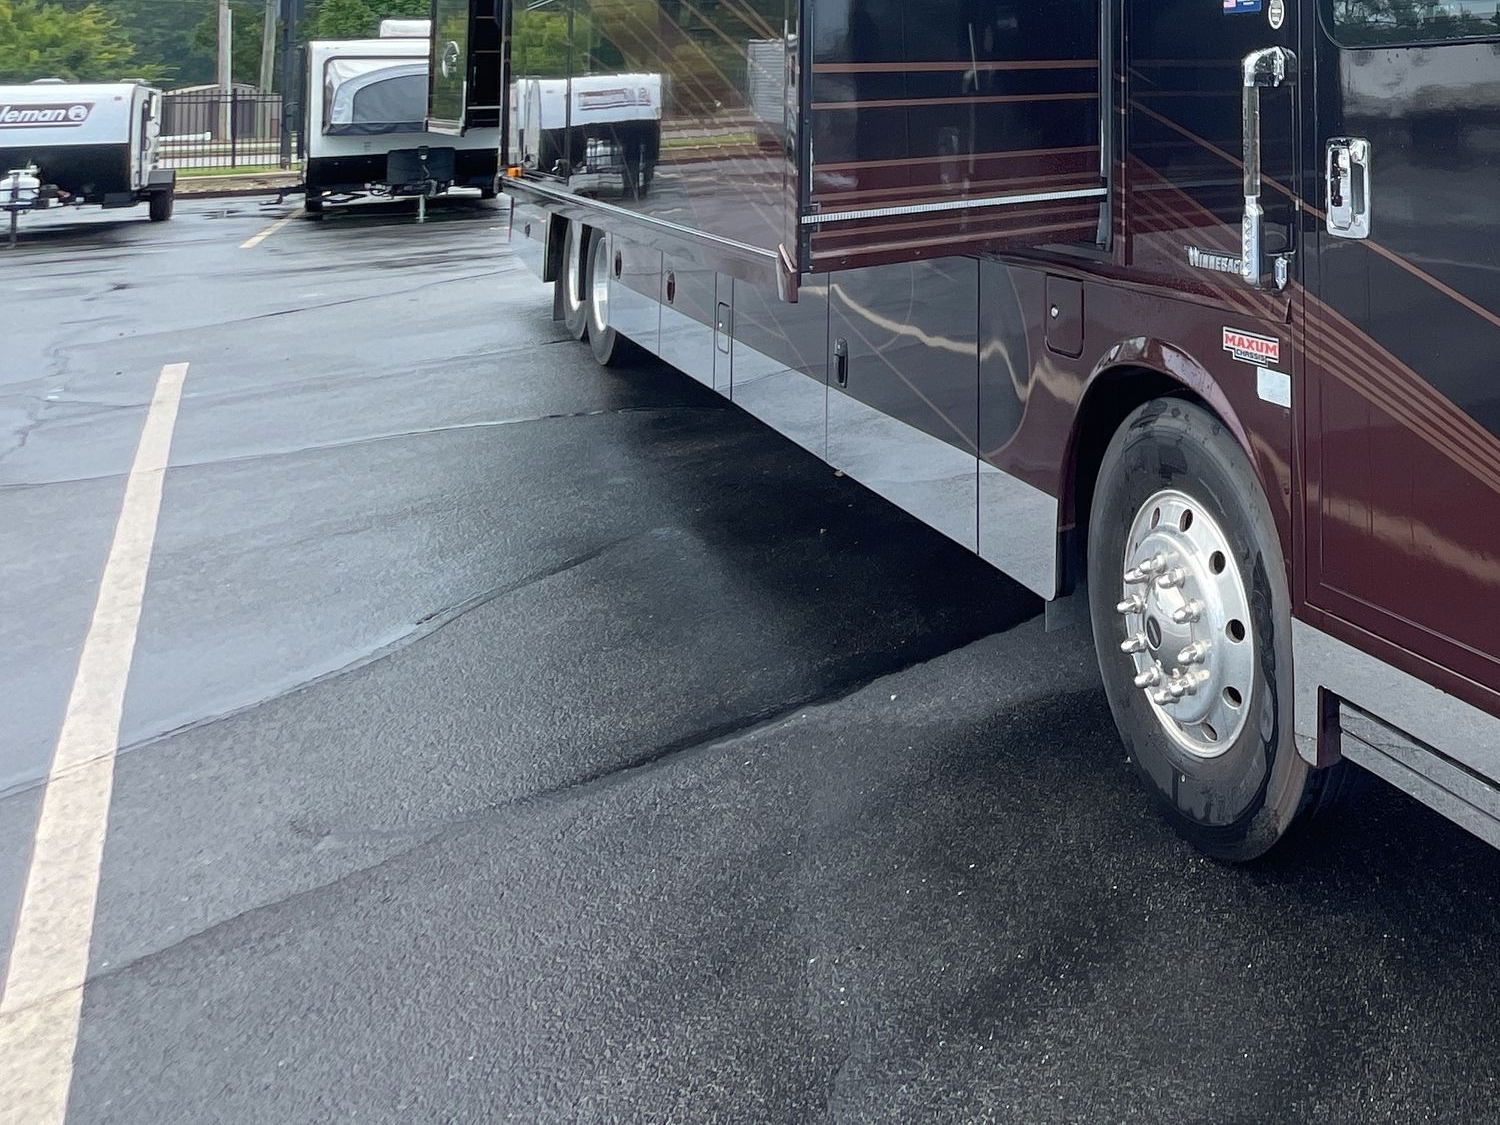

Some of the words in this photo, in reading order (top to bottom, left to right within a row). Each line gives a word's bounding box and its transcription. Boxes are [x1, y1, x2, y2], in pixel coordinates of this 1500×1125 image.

[1185, 246, 1243, 274] WINNEBAG
[1224, 333, 1278, 356] MAXUM
[1235, 348, 1265, 362] CHASSIS
